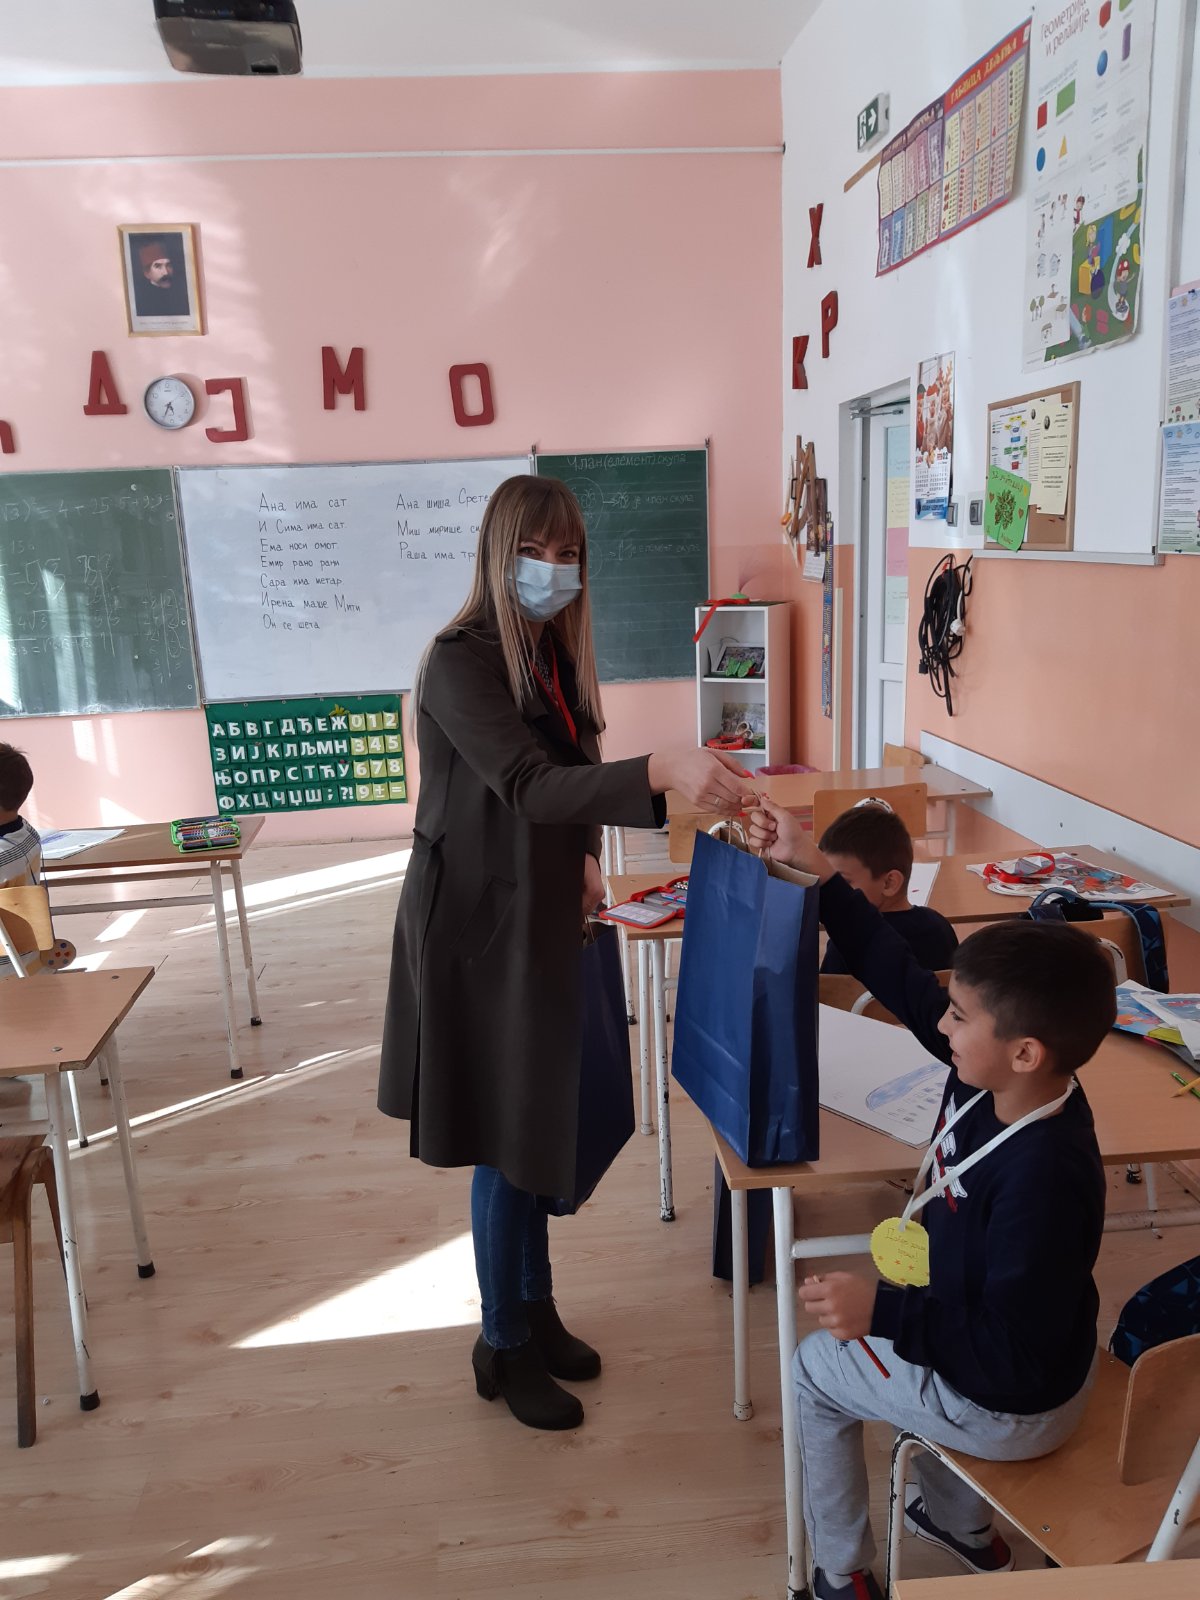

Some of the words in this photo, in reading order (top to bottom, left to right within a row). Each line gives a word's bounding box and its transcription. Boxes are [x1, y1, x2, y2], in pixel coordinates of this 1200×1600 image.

[259, 492, 286, 512] Ана
[296, 501, 318, 510] има
[328, 498, 347, 508] сат
[396, 493, 419, 510] Ана
[427, 499, 451, 509] шиша
[458, 487, 489, 508] Срете
[259, 520, 267, 532] И
[276, 519, 303, 534] Сима
[307, 522, 324, 530] има
[397, 520, 420, 536] Миш
[428, 526, 463, 536] мирише
[260, 538, 283, 552] Ема
[290, 542, 308, 550] носи
[399, 541, 427, 559] Раша
[434, 552, 455, 560] има
[260, 555, 284, 570] Емир
[292, 560, 313, 570] рано
[320, 560, 340, 571] рани
[261, 573, 286, 590] Сара
[262, 591, 295, 614] Ирена
[334, 594, 361, 612] Мити
[263, 614, 276, 629] Он
[283, 621, 292, 630] се
[298, 621, 320, 629] шета
